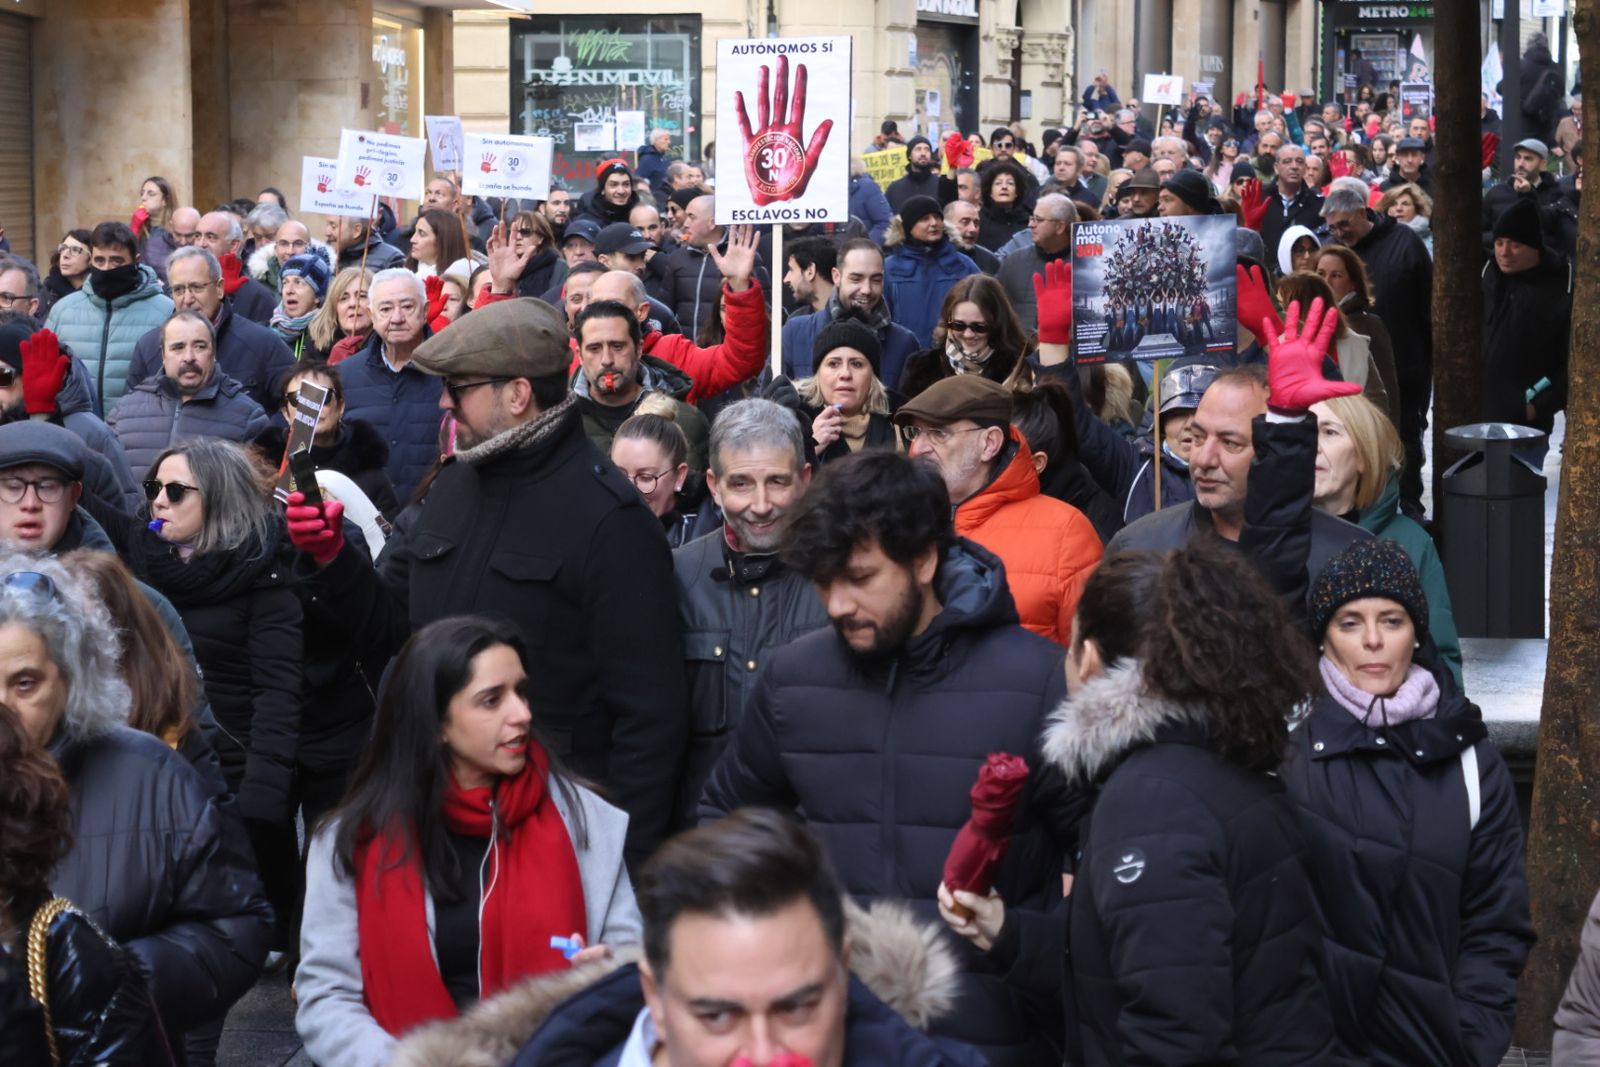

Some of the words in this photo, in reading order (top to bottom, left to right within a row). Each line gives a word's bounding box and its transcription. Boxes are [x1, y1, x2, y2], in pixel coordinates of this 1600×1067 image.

[731, 42, 817, 55] AUTÓNOMOS
[822, 40, 833, 53] SÍ
[507, 157, 520, 167] 30
[761, 148, 787, 169] 30
[386, 172, 398, 182] 30
[769, 169, 779, 181] N
[731, 208, 800, 221] ESCLAVOS
[805, 208, 828, 219] NO
[1076, 223, 1121, 236] Autono
[1076, 234, 1103, 245] mos
